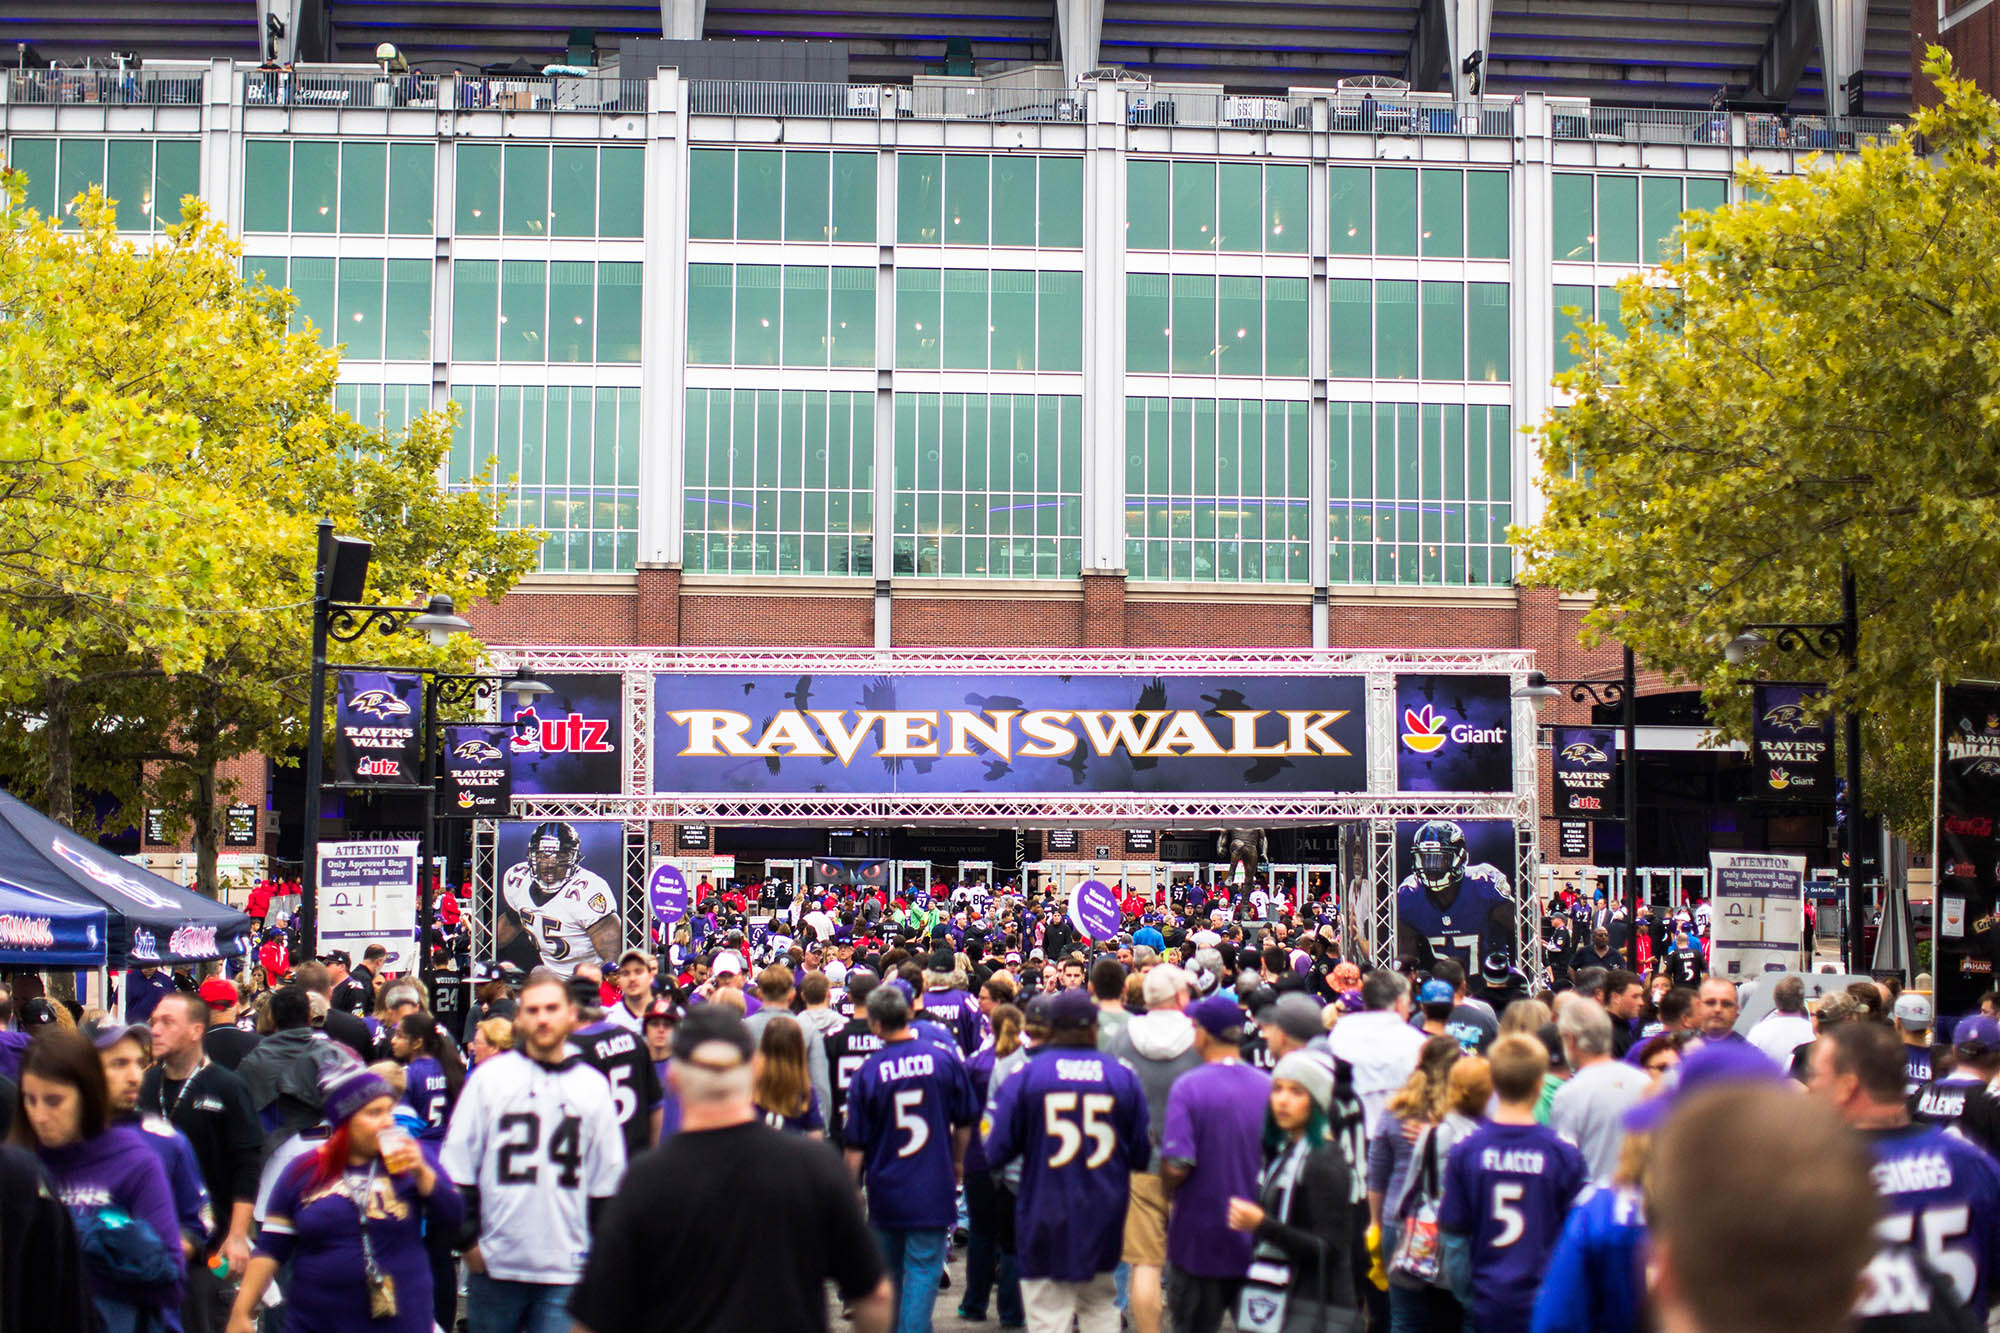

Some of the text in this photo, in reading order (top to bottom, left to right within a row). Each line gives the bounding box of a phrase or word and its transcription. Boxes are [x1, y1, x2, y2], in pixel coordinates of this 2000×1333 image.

[344, 727, 414, 737] RAVENS
[1450, 724, 1504, 743] Giant
[351, 737, 406, 748] WALK
[667, 709, 1353, 767] RAVENSWALK
[1760, 741, 1827, 752] RAVENS
[1767, 752, 1819, 762] WALK
[450, 769, 506, 778] RAVENS
[1558, 771, 1611, 780] RAVENS
[456, 778, 500, 786] WALK
[1563, 780, 1606, 788] WALK
[1791, 775, 1816, 786] Giant
[475, 796, 496, 805] Giant
[335, 845, 400, 856] ATTENTION
[327, 859, 408, 869] Only Approved Bags
[1730, 857, 1789, 868] ATTENTION
[331, 868, 404, 878] Beyond This Point
[1723, 871, 1739, 880] Only
[1742, 871, 1776, 881] Approved
[1726, 880, 1752, 888] Beyond
[1754, 880, 1770, 888] This
[1174, 888, 1184, 899] 57
[1256, 898, 1262, 908] 5
[1683, 961, 1695, 981] 5
[437, 986, 460, 1012] 24
[879, 1054, 934, 1083] FLACCO
[429, 1096, 446, 1129] 5
[894, 1089, 929, 1159] 5
[1044, 1092, 1116, 1170] 55
[498, 1112, 583, 1190] 24
[1482, 1147, 1544, 1175] FLACCO
[1870, 1153, 1953, 1196] SUGGS
[1491, 1182, 1525, 1249] 5
